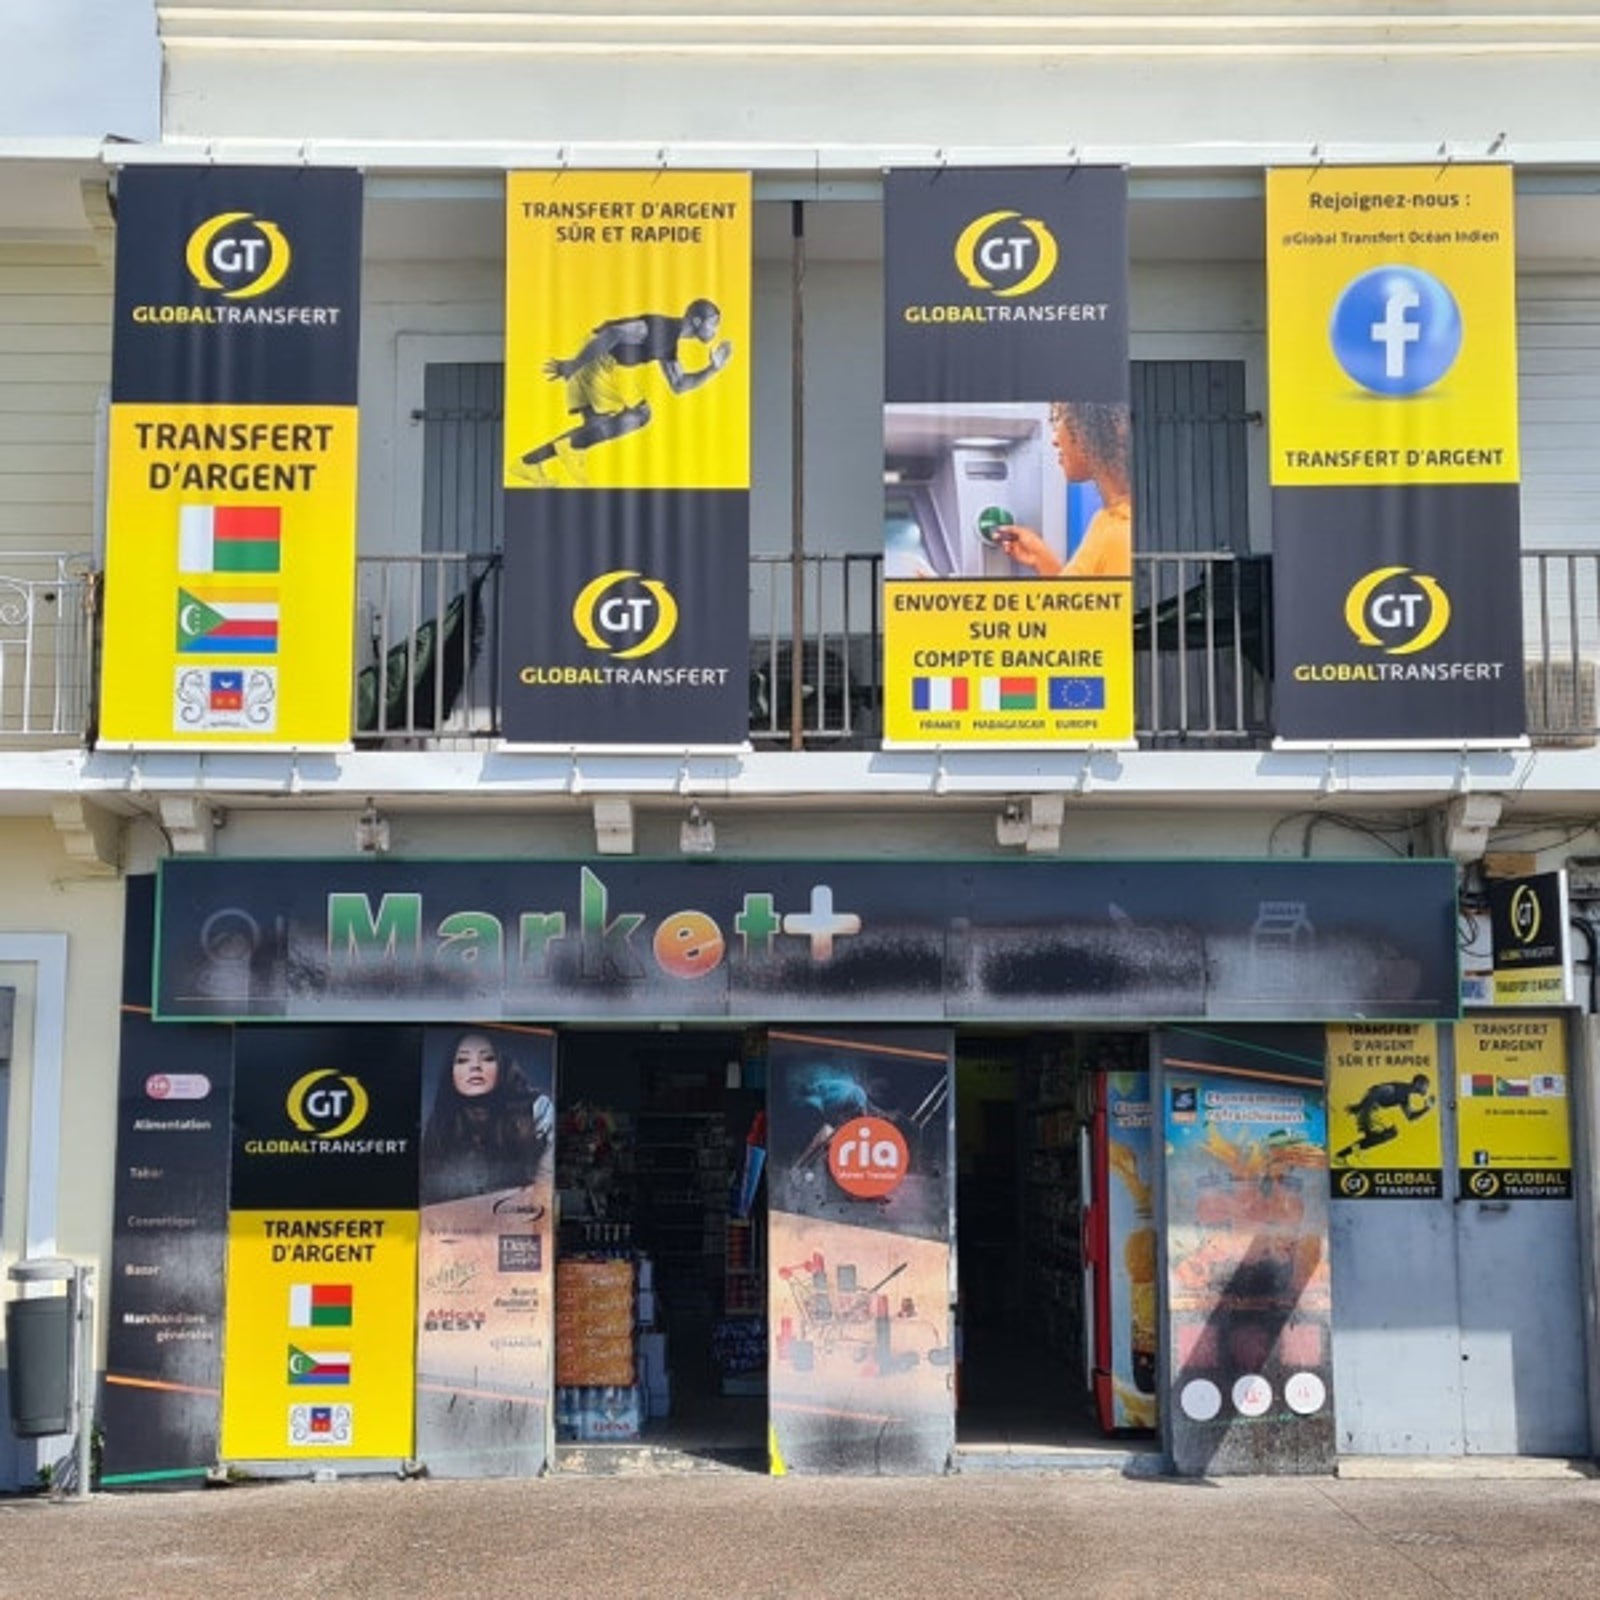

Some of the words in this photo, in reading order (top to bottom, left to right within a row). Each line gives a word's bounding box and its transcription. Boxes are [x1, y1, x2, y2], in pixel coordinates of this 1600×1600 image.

[522, 201, 633, 219] TRANSFERT
[641, 200, 736, 219] D'ARGENT
[1310, 192, 1459, 212] Rejoignez-nous
[556, 221, 594, 243] SÛR
[602, 224, 624, 243] ET
[630, 224, 703, 244] RAPIDE
[1455, 229, 1499, 243] Indien
[211, 238, 265, 274] GT
[980, 236, 1031, 270] GT
[132, 305, 340, 325] GLOBALTRANSFERT
[904, 303, 1109, 325] GLOBALTRANSFERT
[135, 422, 334, 453] TRANSFERT
[1285, 448, 1400, 469] TRANSFERT
[1406, 447, 1504, 467] D'ARGENT
[149, 463, 318, 492] D'ARGENT
[894, 594, 987, 612] ENVOYEZ
[994, 595, 1020, 611] DE
[1026, 593, 1123, 611] L'ARGENT
[1371, 594, 1424, 628] GT
[598, 598, 651, 632] GT
[969, 622, 1011, 639] SUR
[1018, 622, 1047, 639] UN
[914, 650, 994, 668] COMPTE
[1001, 650, 1104, 667] BANCAIRE
[520, 667, 729, 687] GLOBALTRANSFERT
[1294, 662, 1504, 682] GLOBALTRANSFERT
[919, 719, 962, 731] FRANCE
[1055, 719, 1099, 730] EUROPE
[1472, 1023, 1548, 1035] TRANSFERT
[1353, 1040, 1414, 1051] D'ARGENT
[1479, 1040, 1544, 1052] D'ARGENT
[1367, 1054, 1381, 1066] ET
[1385, 1054, 1431, 1066] RAPIDE
[305, 1088, 349, 1120] GT
[244, 1139, 408, 1156] GLOBALTRANSFERT
[838, 1126, 899, 1168] ria
[1375, 1173, 1436, 1185] GLOBAL
[1503, 1173, 1565, 1184] GLOBAL
[1375, 1186, 1437, 1196] TRANSFERT
[1504, 1186, 1566, 1195] TRANSFERT
[264, 1220, 386, 1239] TRANSFERT
[272, 1243, 374, 1264] D'ARGENT
[425, 1309, 486, 1320] Africa's
[424, 1320, 485, 1331] BEST
